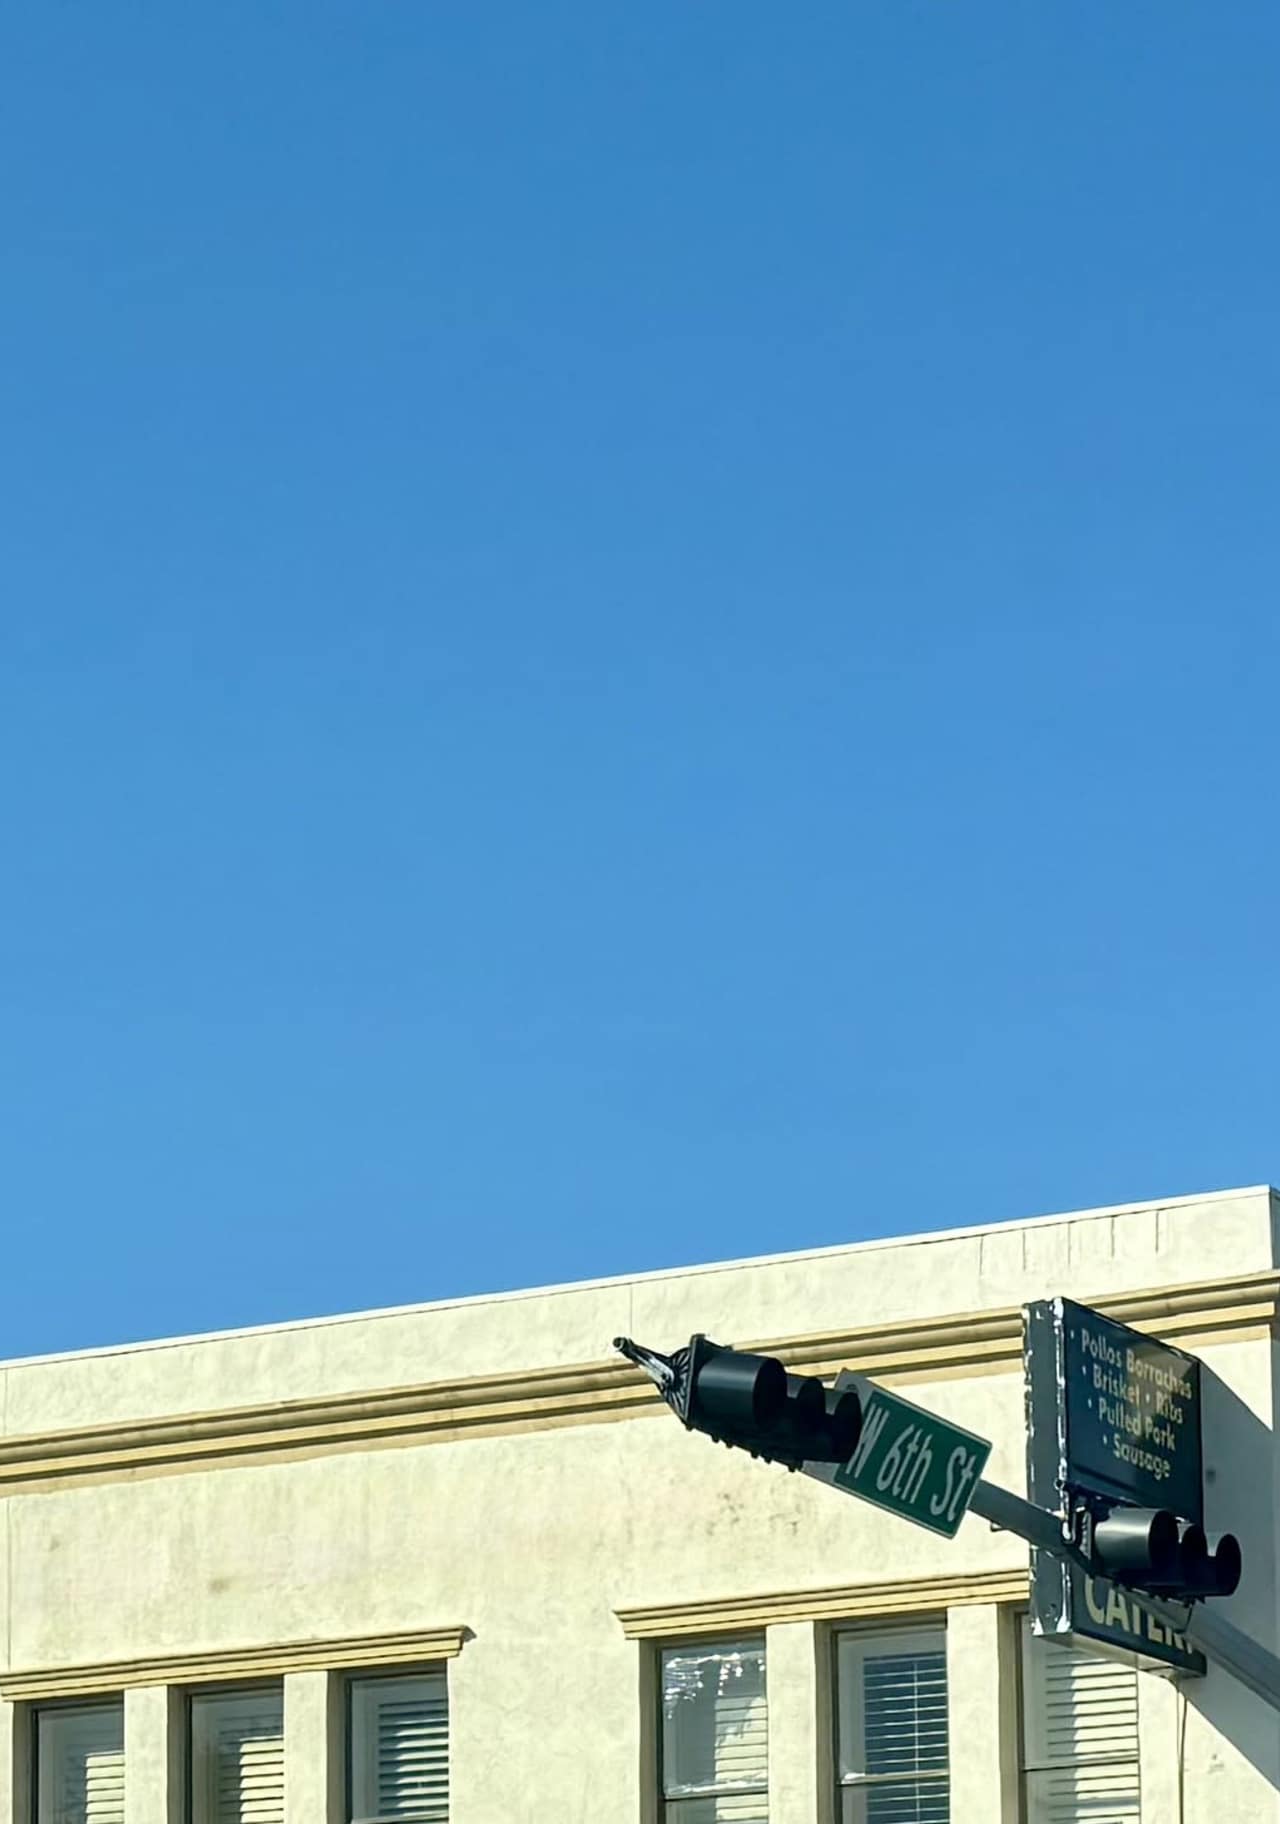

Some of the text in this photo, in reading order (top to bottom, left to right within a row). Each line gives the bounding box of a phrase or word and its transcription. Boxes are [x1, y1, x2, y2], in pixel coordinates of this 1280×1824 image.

[1081, 1328, 1192, 1400] Pollos Borrachos
[1093, 1362, 1183, 1424] Brisket Ribs
[1098, 1397, 1176, 1451] Pulled Pork
[1113, 1433, 1170, 1481] Sausage
[876, 1423, 933, 1505] 6th
[930, 1445, 977, 1523] St
[1084, 1573, 1193, 1655] CATE
